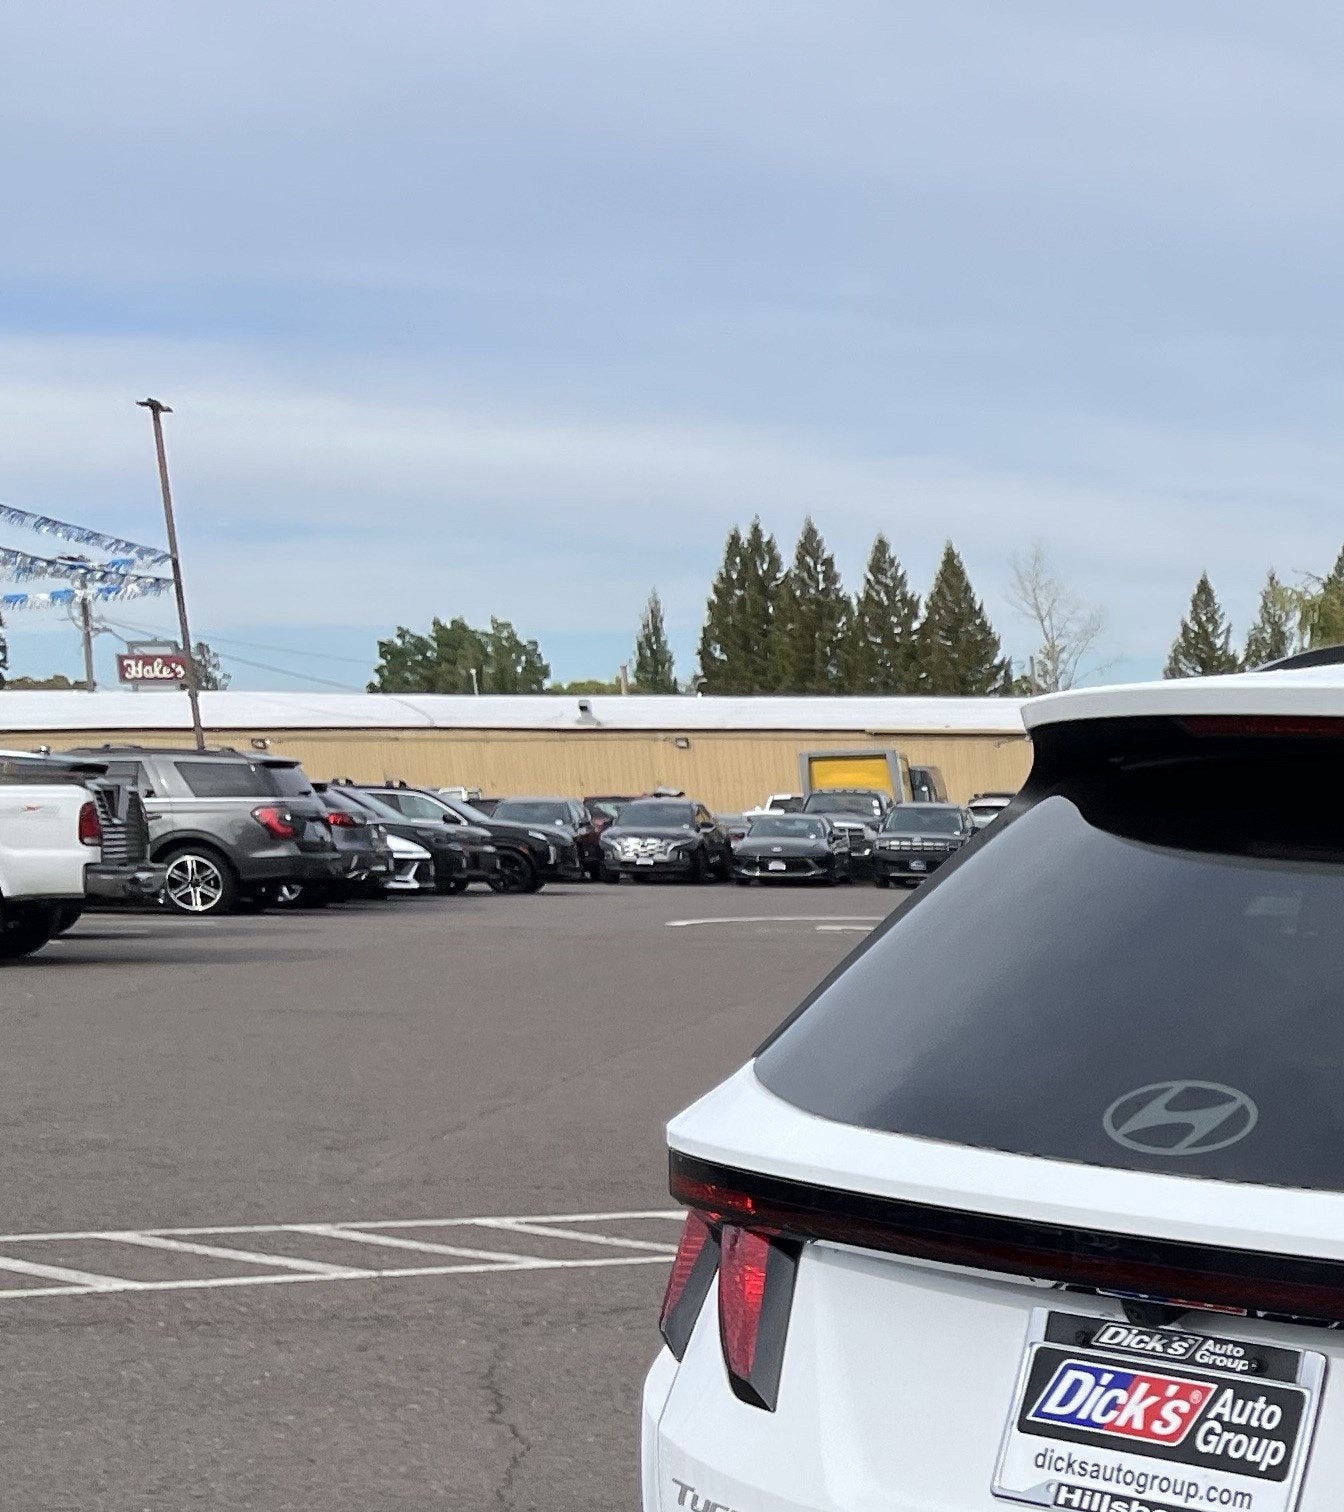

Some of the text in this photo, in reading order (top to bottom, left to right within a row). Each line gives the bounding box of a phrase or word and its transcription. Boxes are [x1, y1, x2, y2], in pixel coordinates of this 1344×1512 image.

[123, 658, 185, 679] Hale's
[1097, 1326, 1245, 1358] Dick's Auto
[1195, 1351, 1249, 1371] Group
[1042, 1370, 1282, 1436] Dick's Auto
[1195, 1421, 1286, 1471] Group
[1034, 1448, 1252, 1510] dicksautogroup.com
